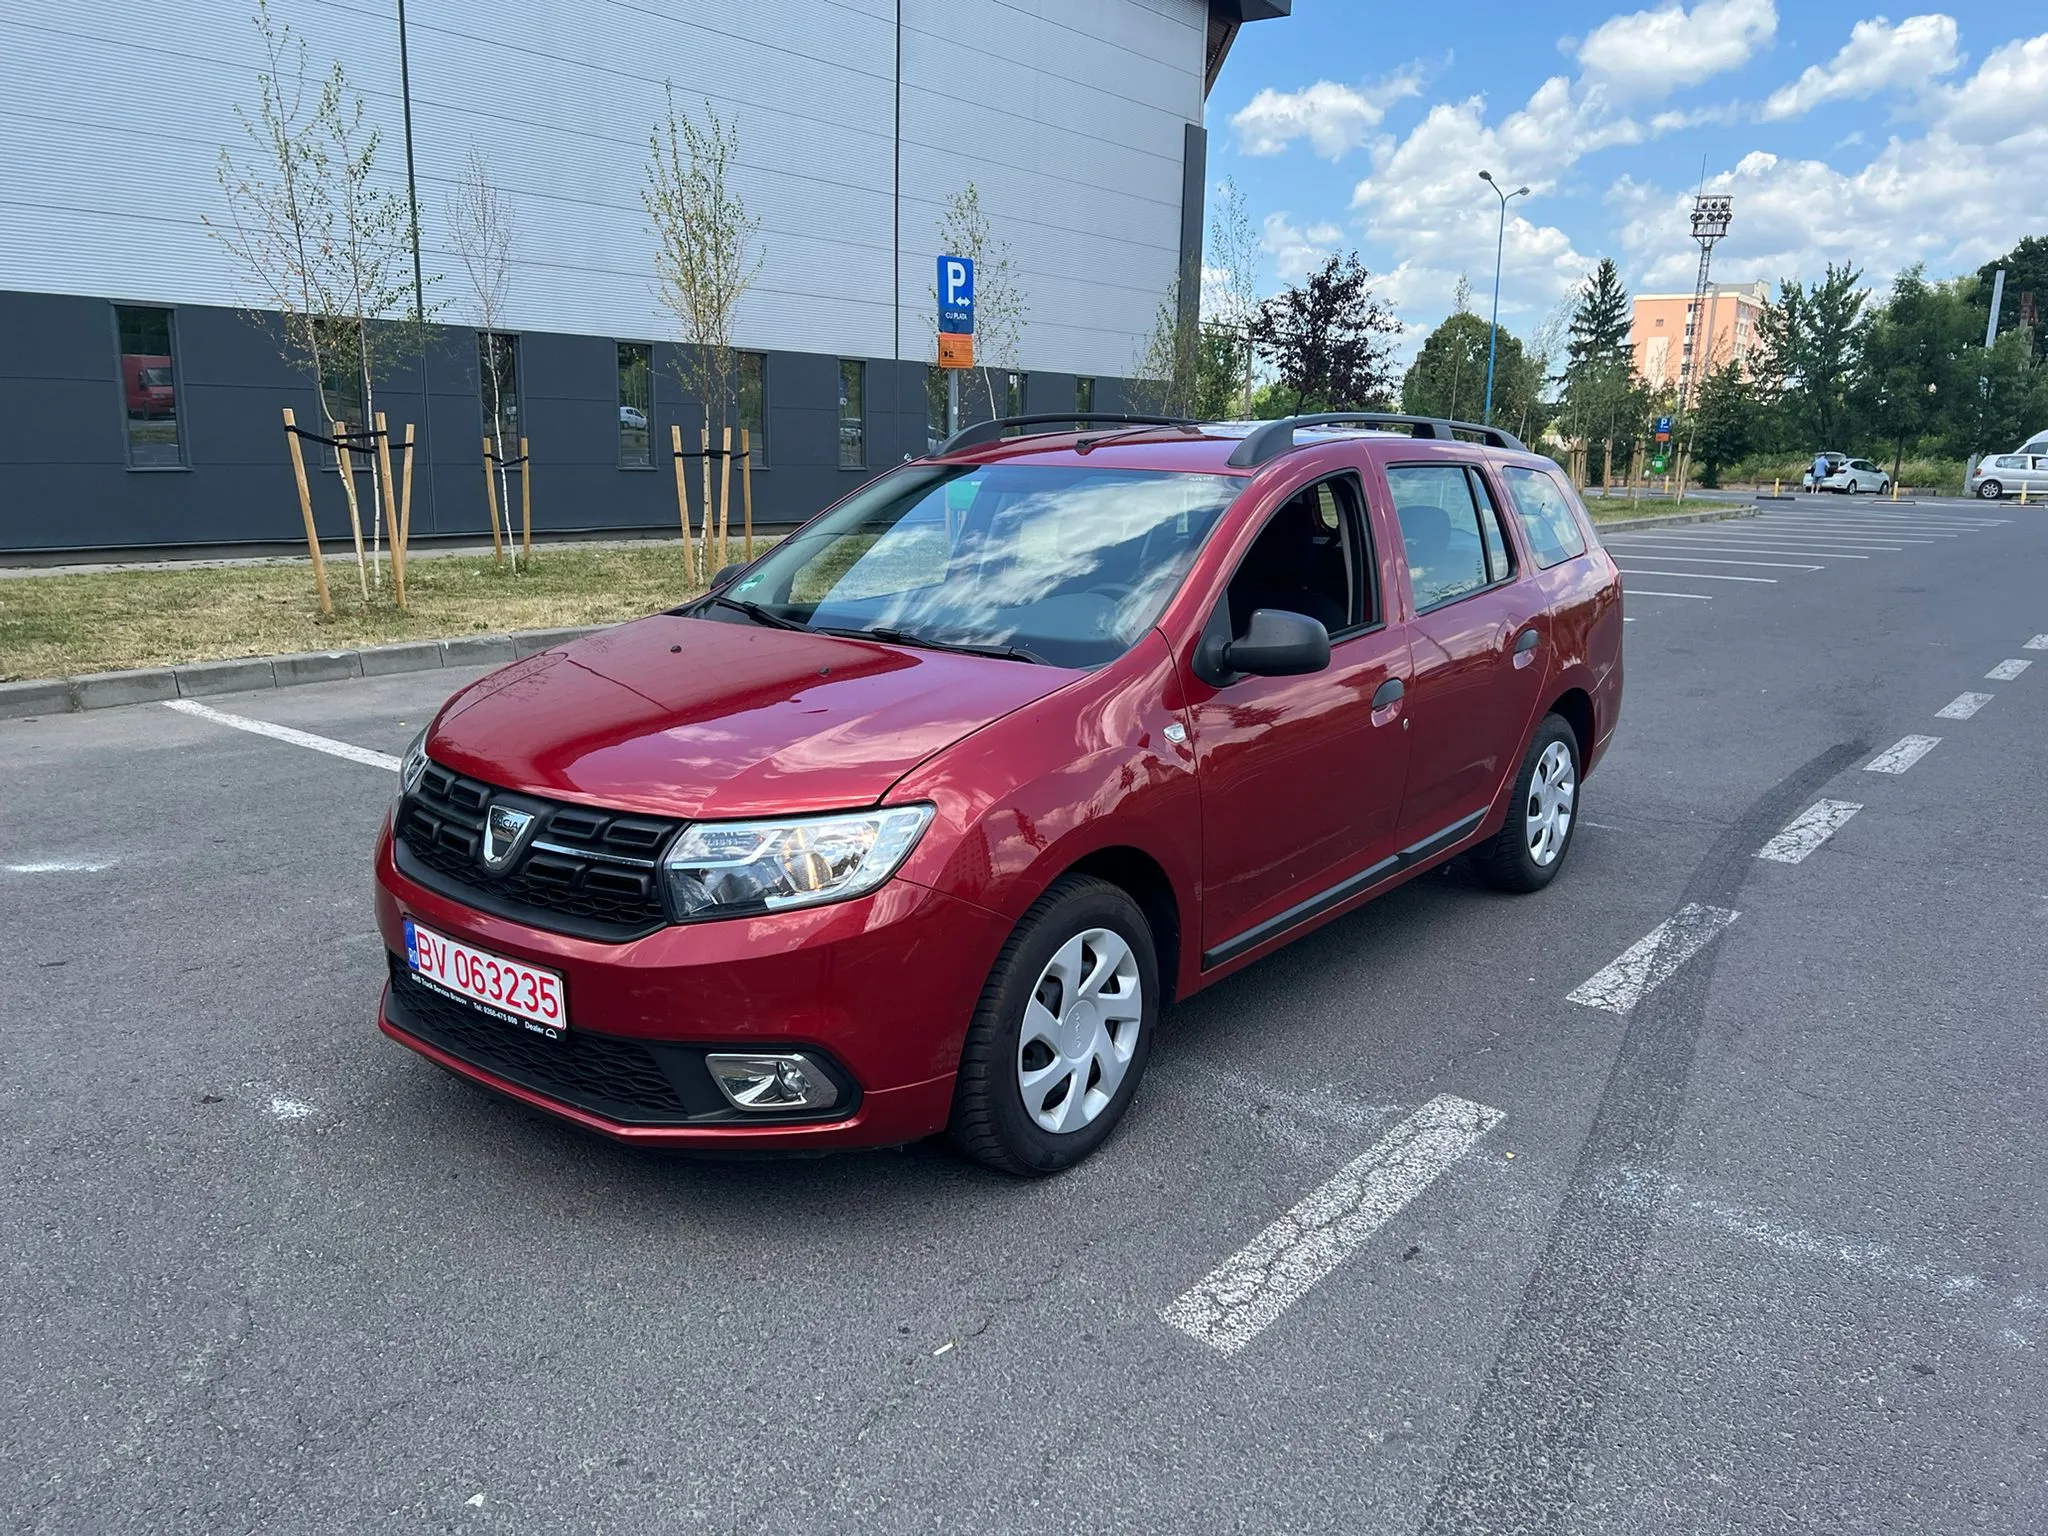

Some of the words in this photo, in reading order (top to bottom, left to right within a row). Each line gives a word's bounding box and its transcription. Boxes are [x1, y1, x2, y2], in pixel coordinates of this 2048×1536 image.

[947, 262, 966, 303] P
[408, 947, 418, 964] RO
[416, 931, 446, 978] BV
[454, 949, 559, 1019] 063235
[524, 1020, 545, 1034] Dealer
